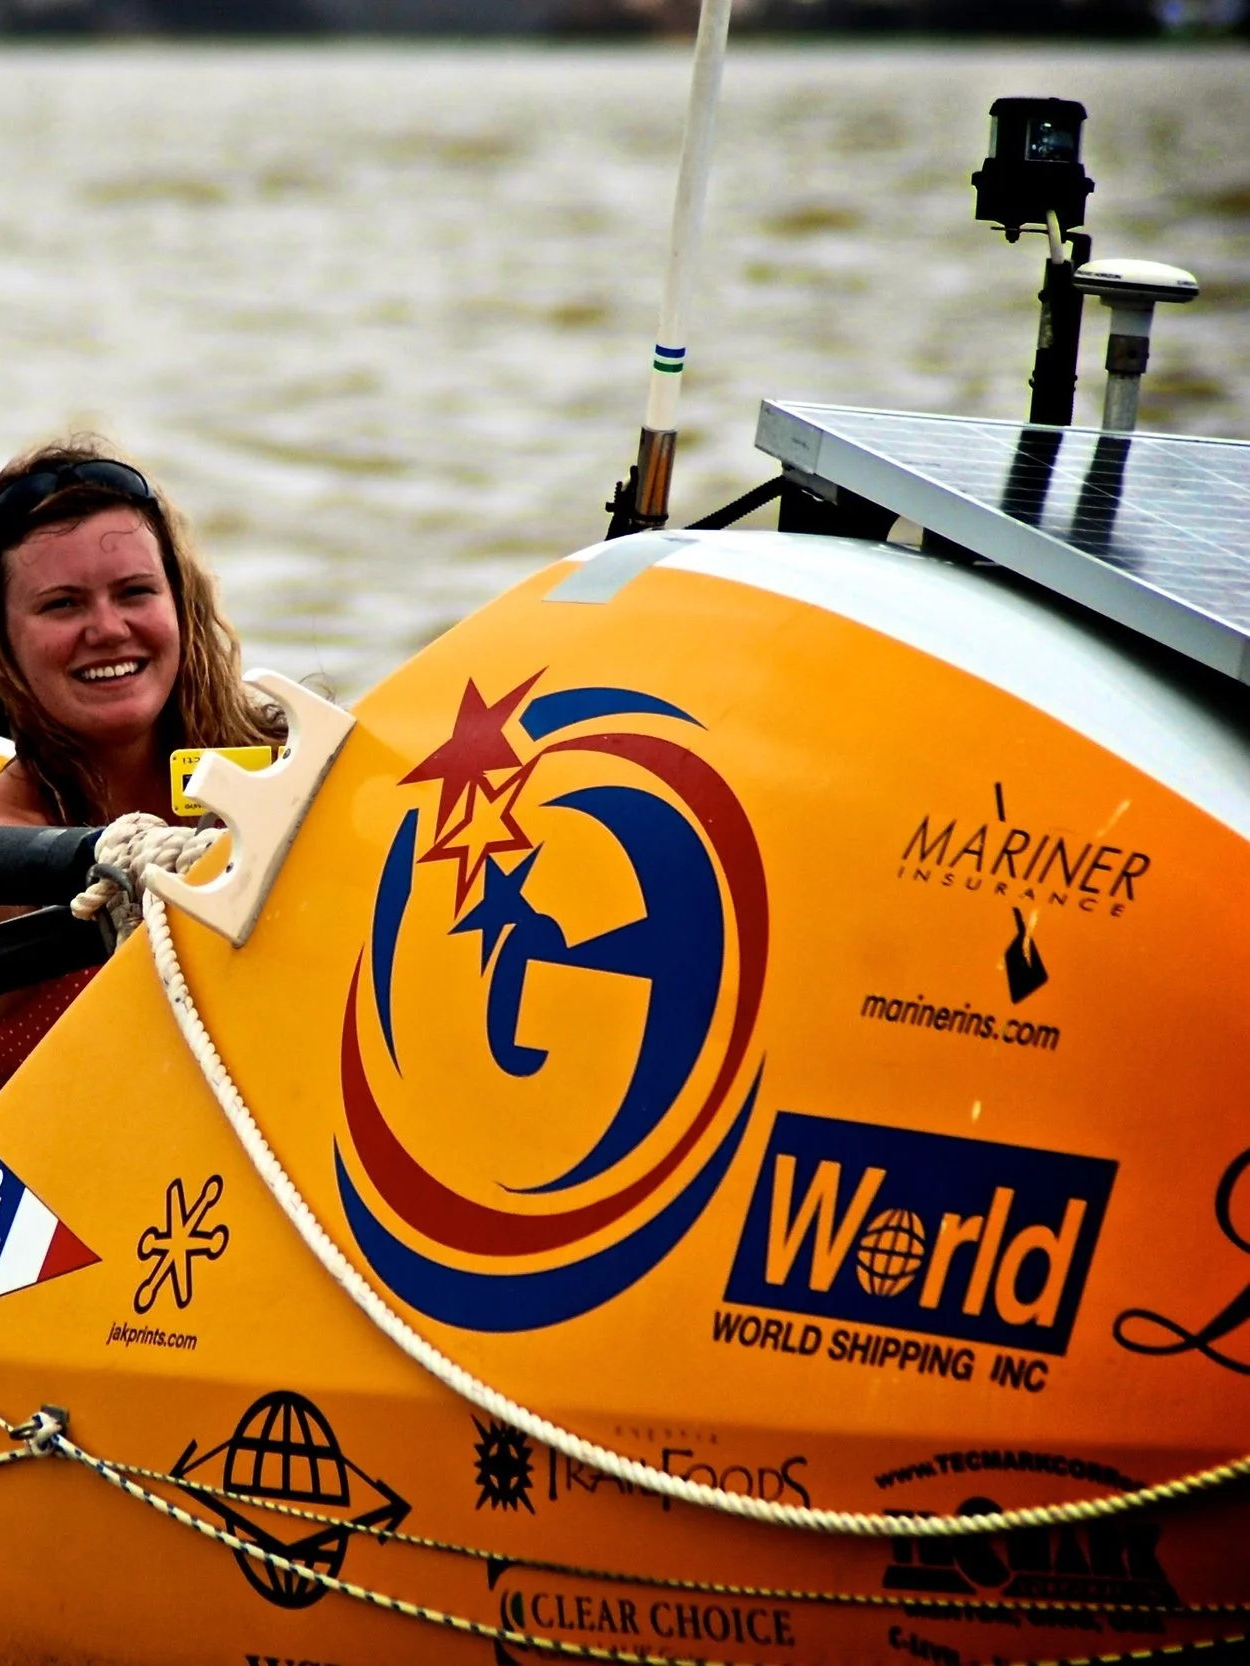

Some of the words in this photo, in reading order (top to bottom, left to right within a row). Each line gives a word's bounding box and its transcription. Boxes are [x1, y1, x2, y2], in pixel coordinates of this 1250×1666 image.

[902, 815, 1151, 901] MARINER
[897, 866, 1125, 918] INSURANCE
[860, 993, 1061, 1051] marinerins.com
[765, 1153, 1088, 1328] World
[106, 1321, 198, 1351] jakprints.com
[712, 1310, 823, 1357] WORLD
[827, 1329, 976, 1382] SHIPPING
[989, 1354, 1050, 1394] INC
[531, 1593, 639, 1635] CLEAR
[649, 1602, 796, 1647] CHOICE
